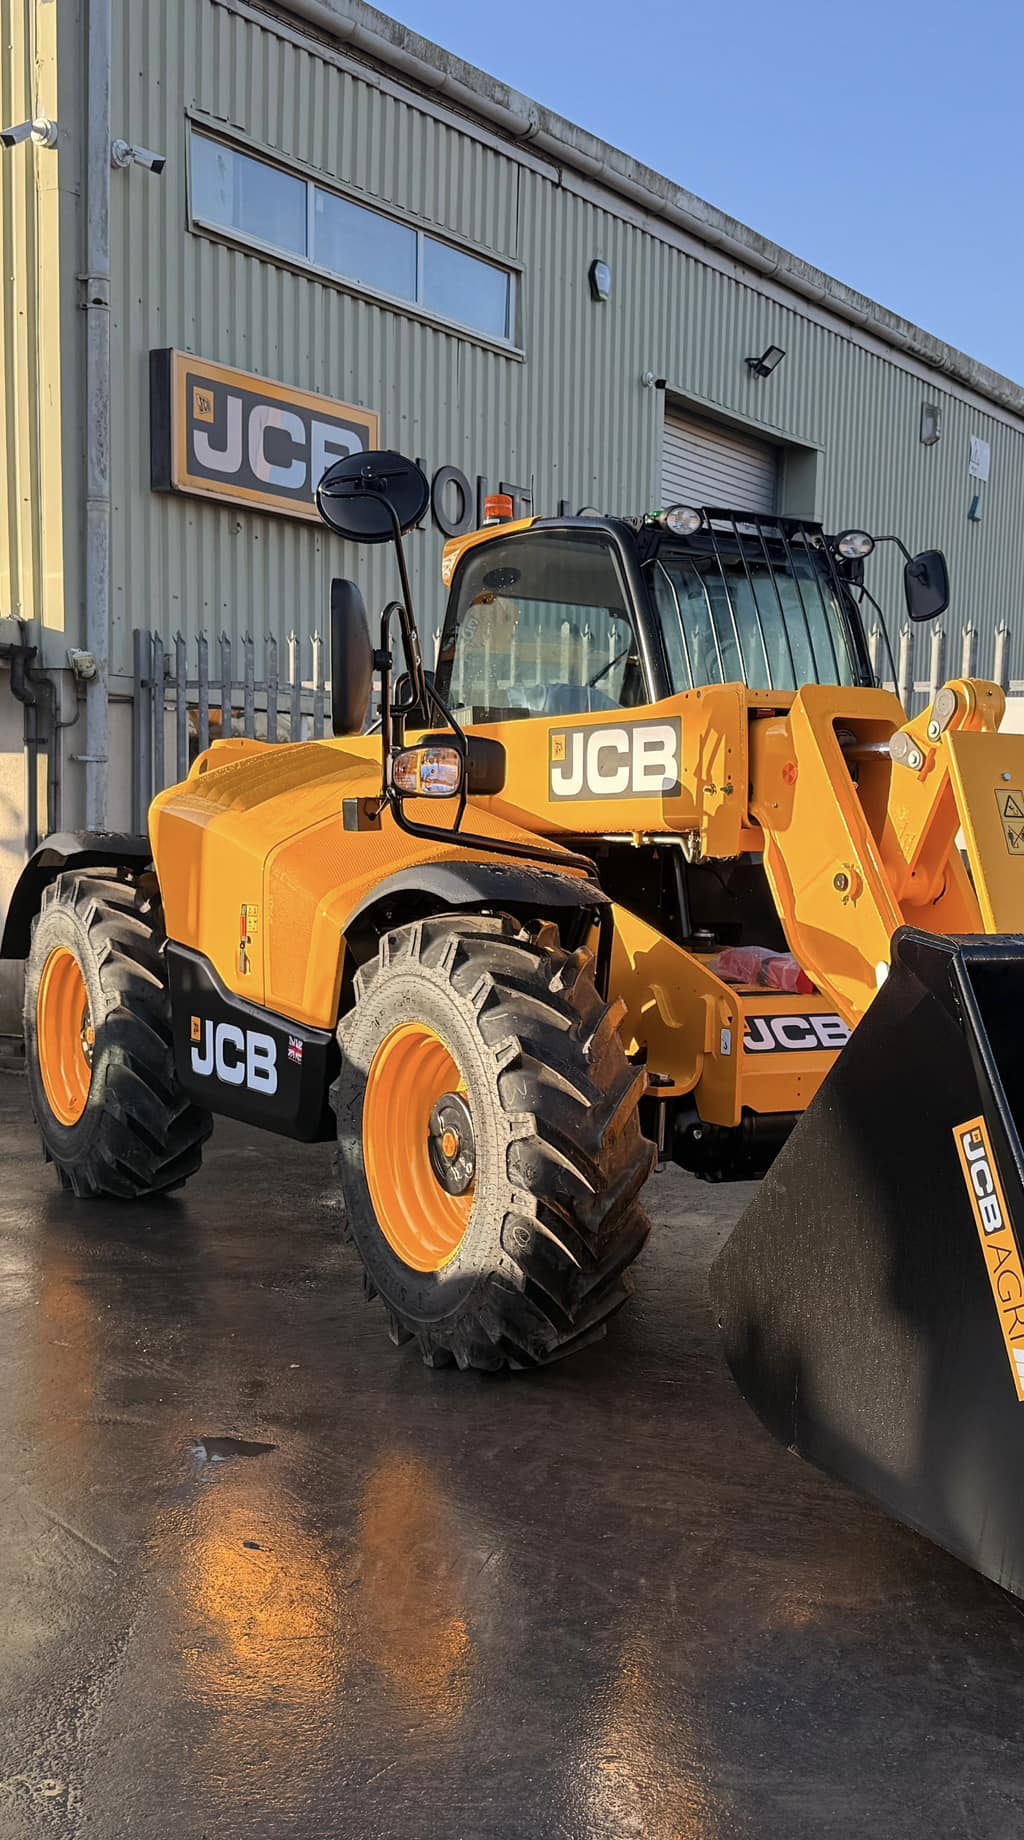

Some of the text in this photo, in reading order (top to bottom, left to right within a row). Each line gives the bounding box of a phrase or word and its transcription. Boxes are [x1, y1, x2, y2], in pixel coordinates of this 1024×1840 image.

[193, 395, 363, 495] JCB
[416, 457, 531, 538] OLT
[551, 725, 678, 796] JCB
[191, 1019, 278, 1095] JCB
[743, 1016, 852, 1050] JCB
[963, 1133, 1003, 1232] JCB
